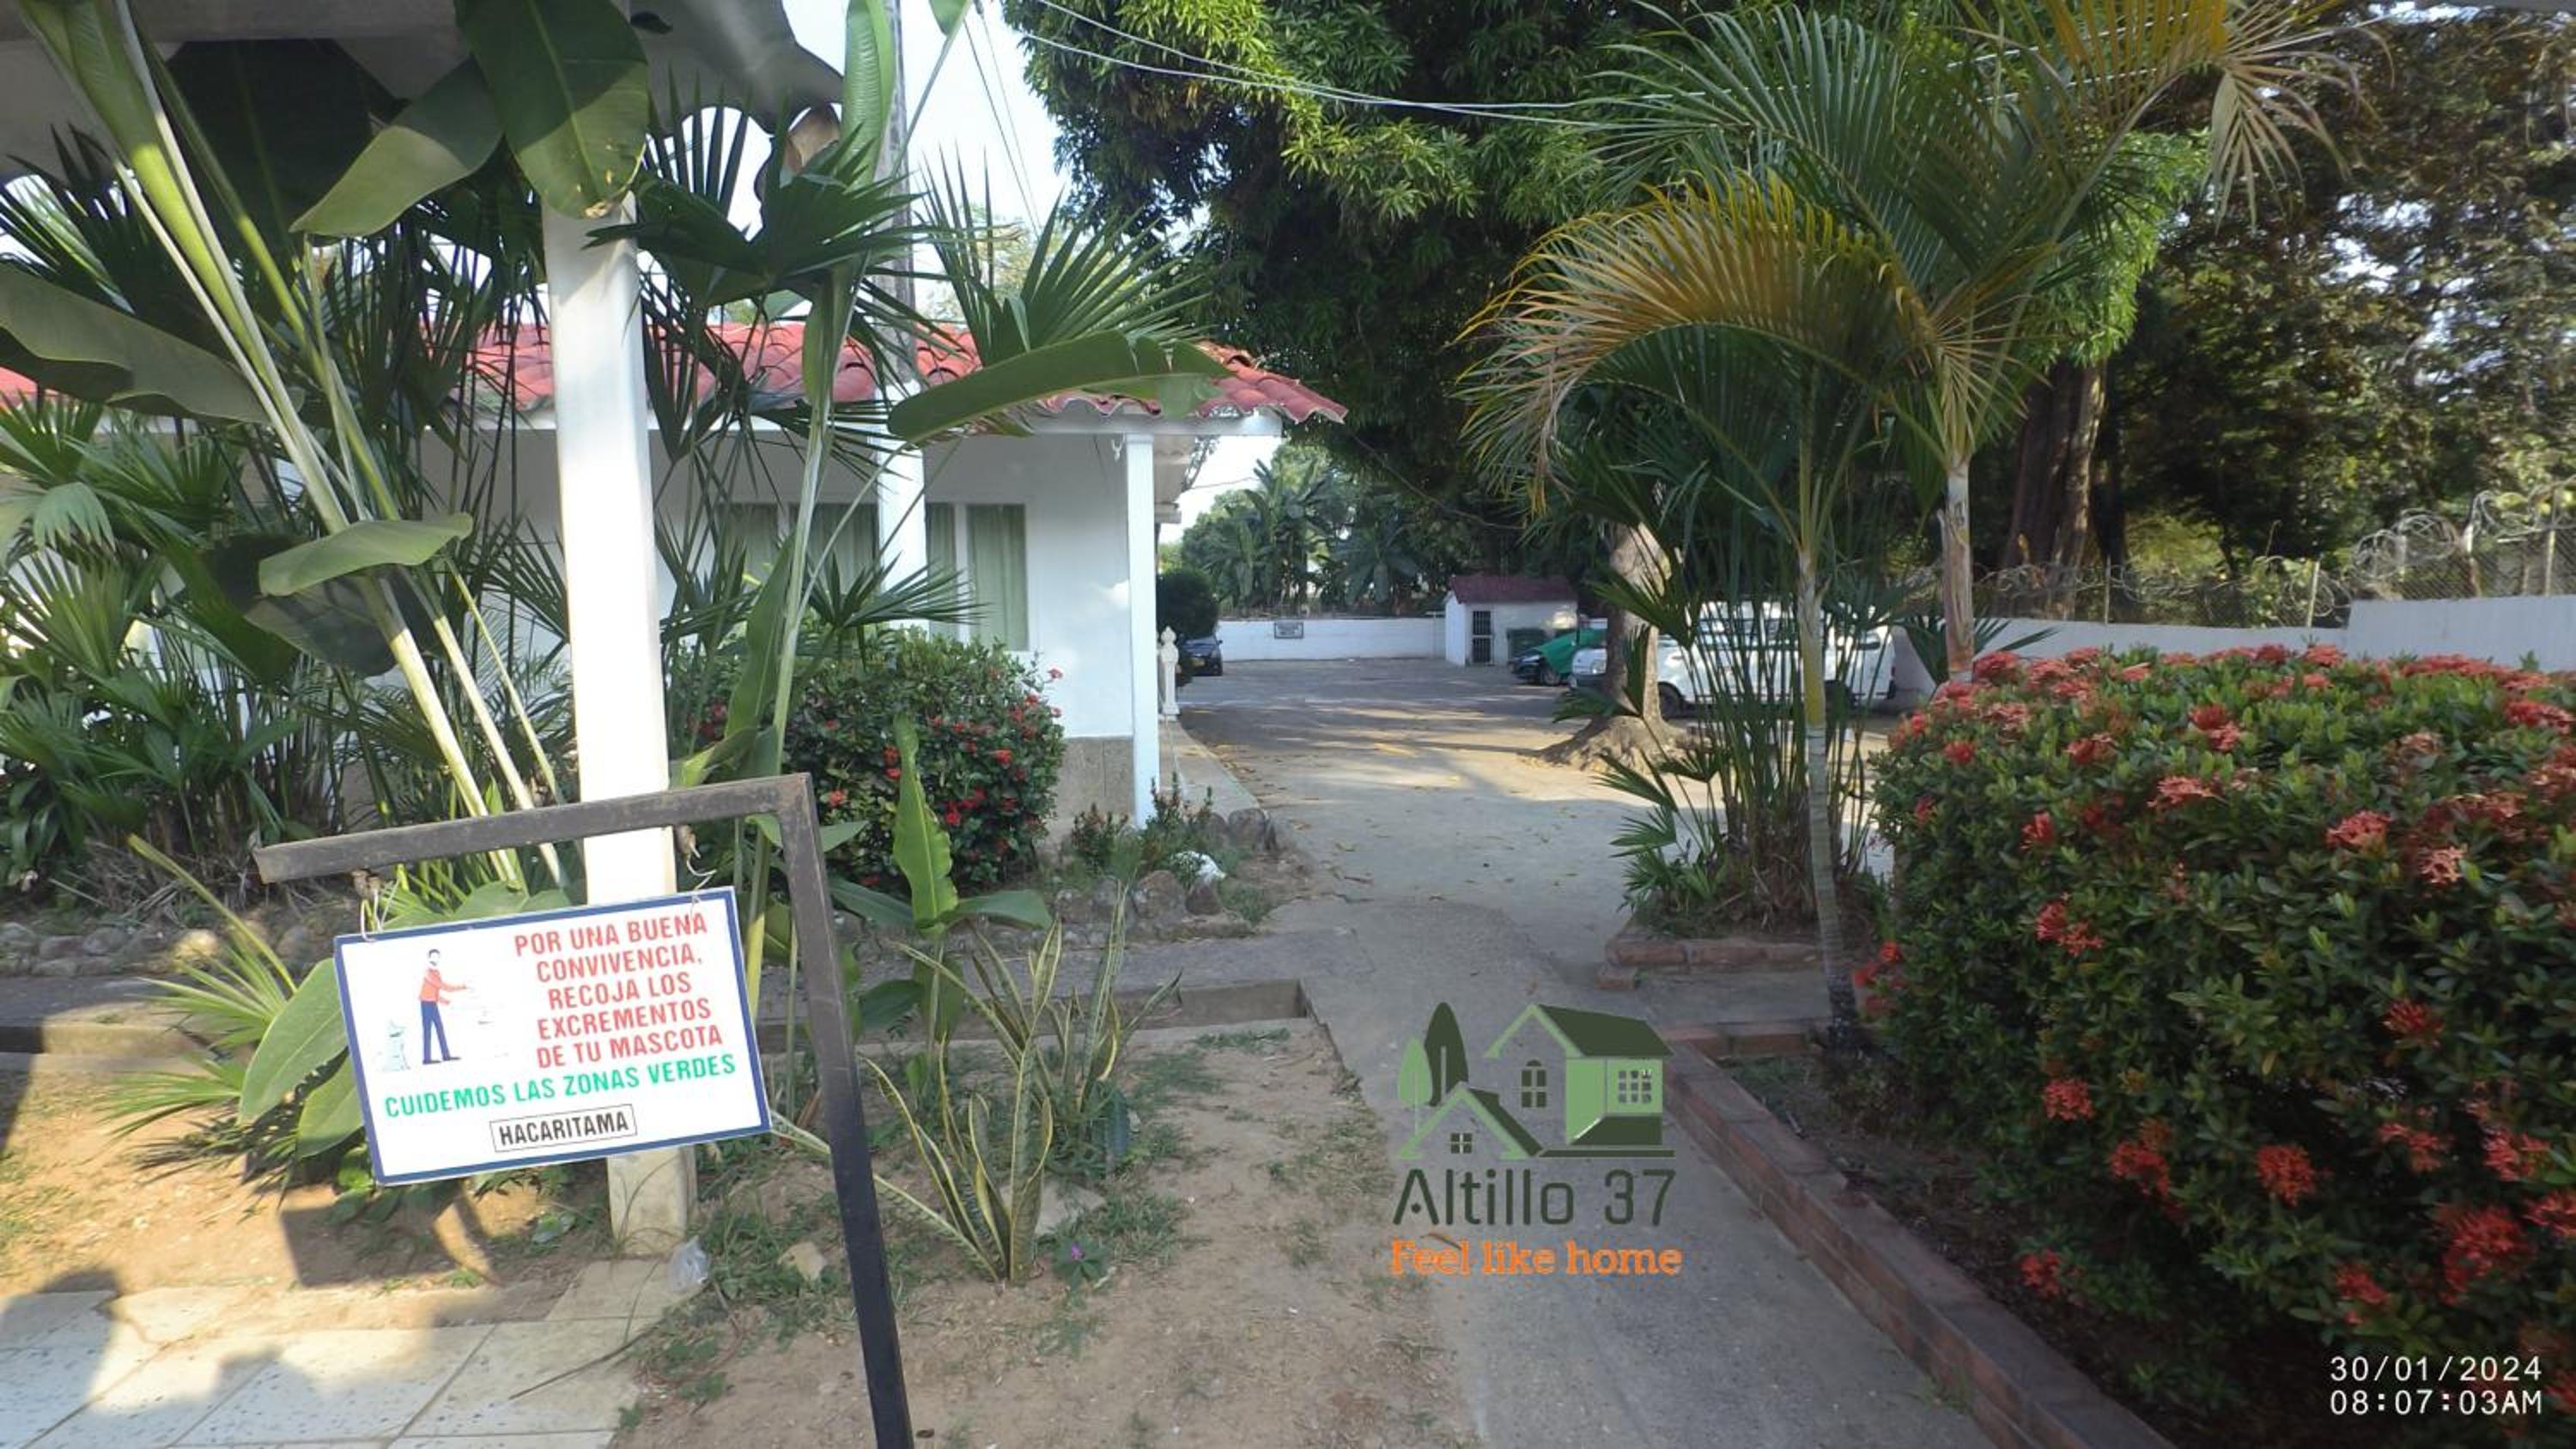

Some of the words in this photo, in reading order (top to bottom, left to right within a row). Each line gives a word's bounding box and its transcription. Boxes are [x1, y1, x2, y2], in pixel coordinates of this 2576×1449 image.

[515, 931, 562, 956] POR
[570, 925, 619, 949] UNA
[628, 912, 708, 943] BUENA
[537, 943, 703, 982] CONVIVENCIA,
[548, 979, 640, 1010] RECOJA
[648, 972, 692, 997] LOS
[537, 997, 712, 1040] EXCREMENTOS
[537, 1045, 565, 1068] DE
[574, 1041, 601, 1064] TU
[610, 1024, 723, 1059] MASCOTA
[384, 1084, 506, 1118] CUIDEMOS
[514, 1077, 556, 1102] LAS
[563, 1067, 640, 1096] ZONAS
[647, 1053, 736, 1086] VERDES
[499, 1112, 629, 1146] HACARITAMA
